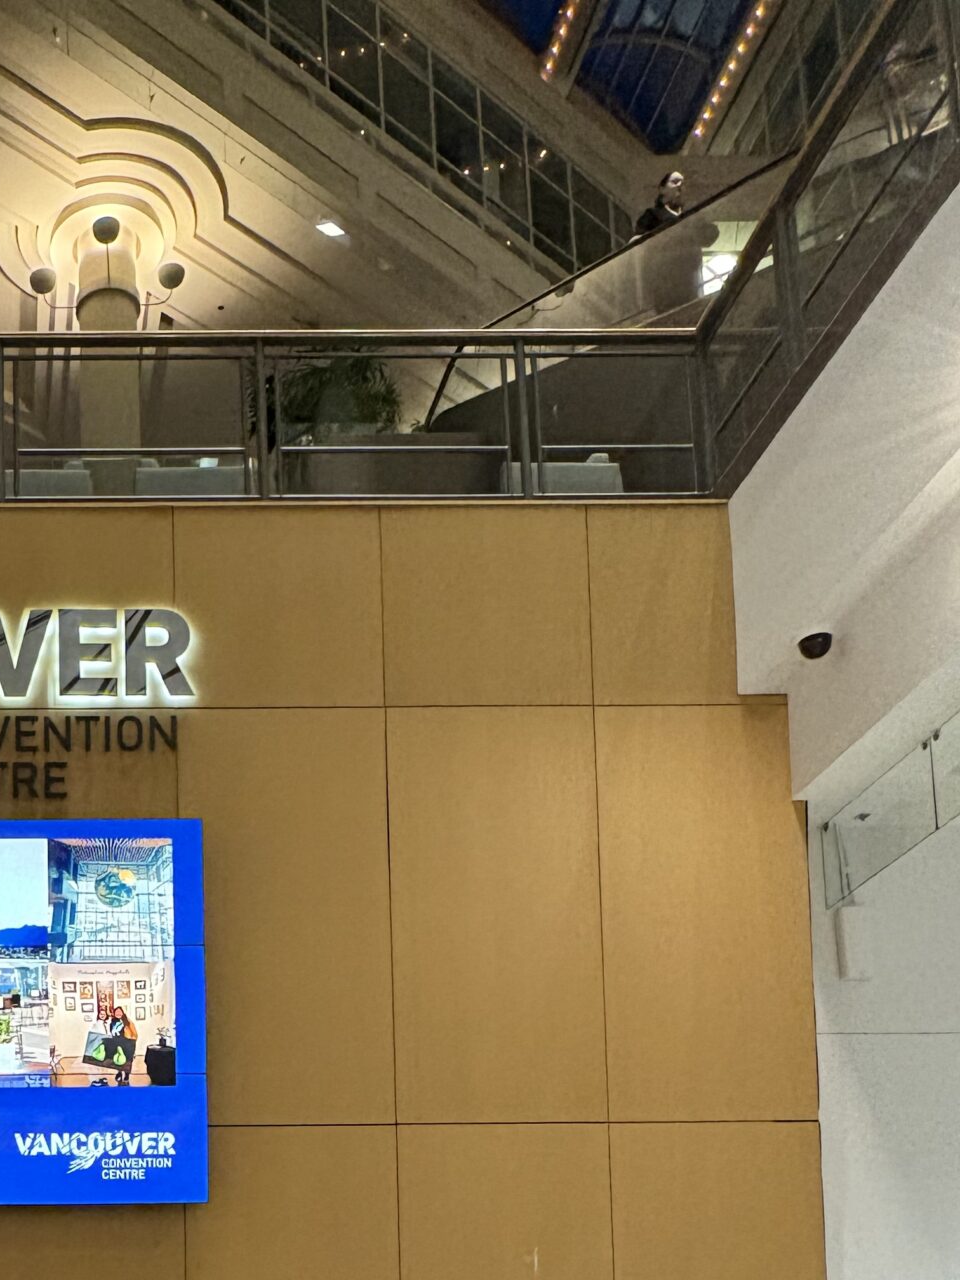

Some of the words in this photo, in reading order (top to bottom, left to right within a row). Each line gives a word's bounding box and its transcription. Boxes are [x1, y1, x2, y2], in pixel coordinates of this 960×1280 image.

[14, 1131, 177, 1157] VANCOUVER
[101, 1157, 172, 1169] CONVENTION
[101, 1169, 146, 1180] CENTRE
